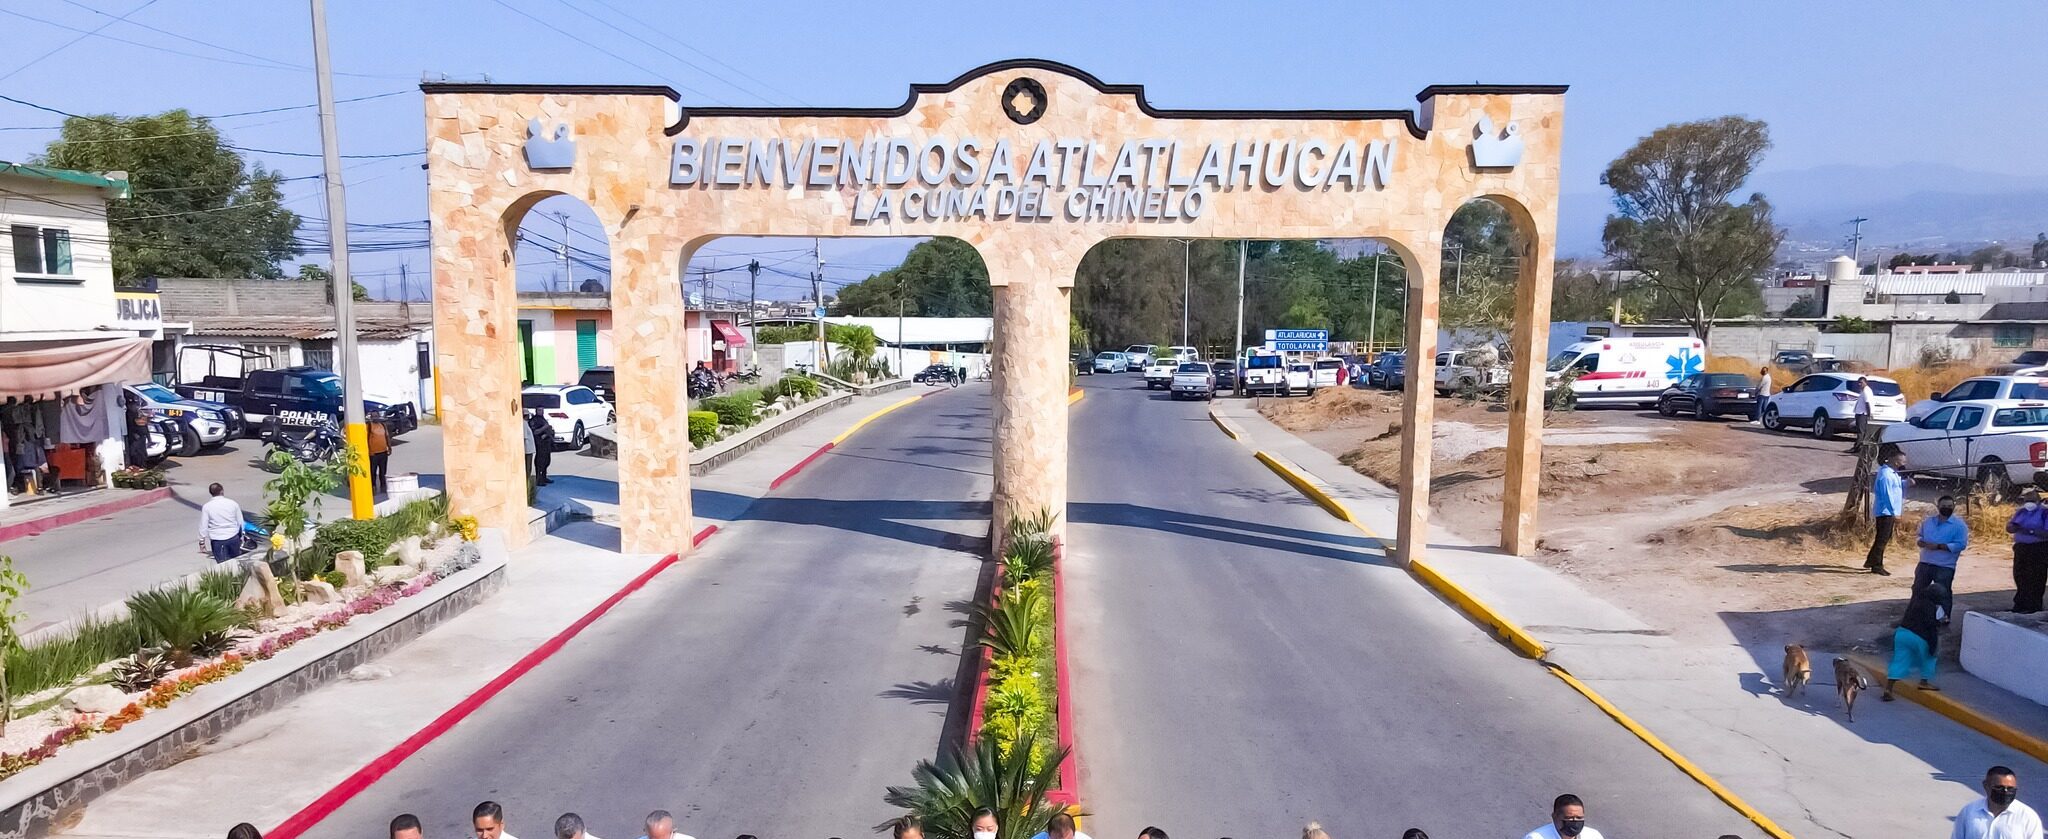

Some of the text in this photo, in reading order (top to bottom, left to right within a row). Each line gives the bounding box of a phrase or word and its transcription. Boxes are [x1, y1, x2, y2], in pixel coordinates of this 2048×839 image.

[670, 138, 1397, 190] BIENVENIDOS A ATLATLAHUCAN
[852, 187, 1206, 221] LA CUNA DEL CHINELO
[117, 298, 160, 321] UBLICA
